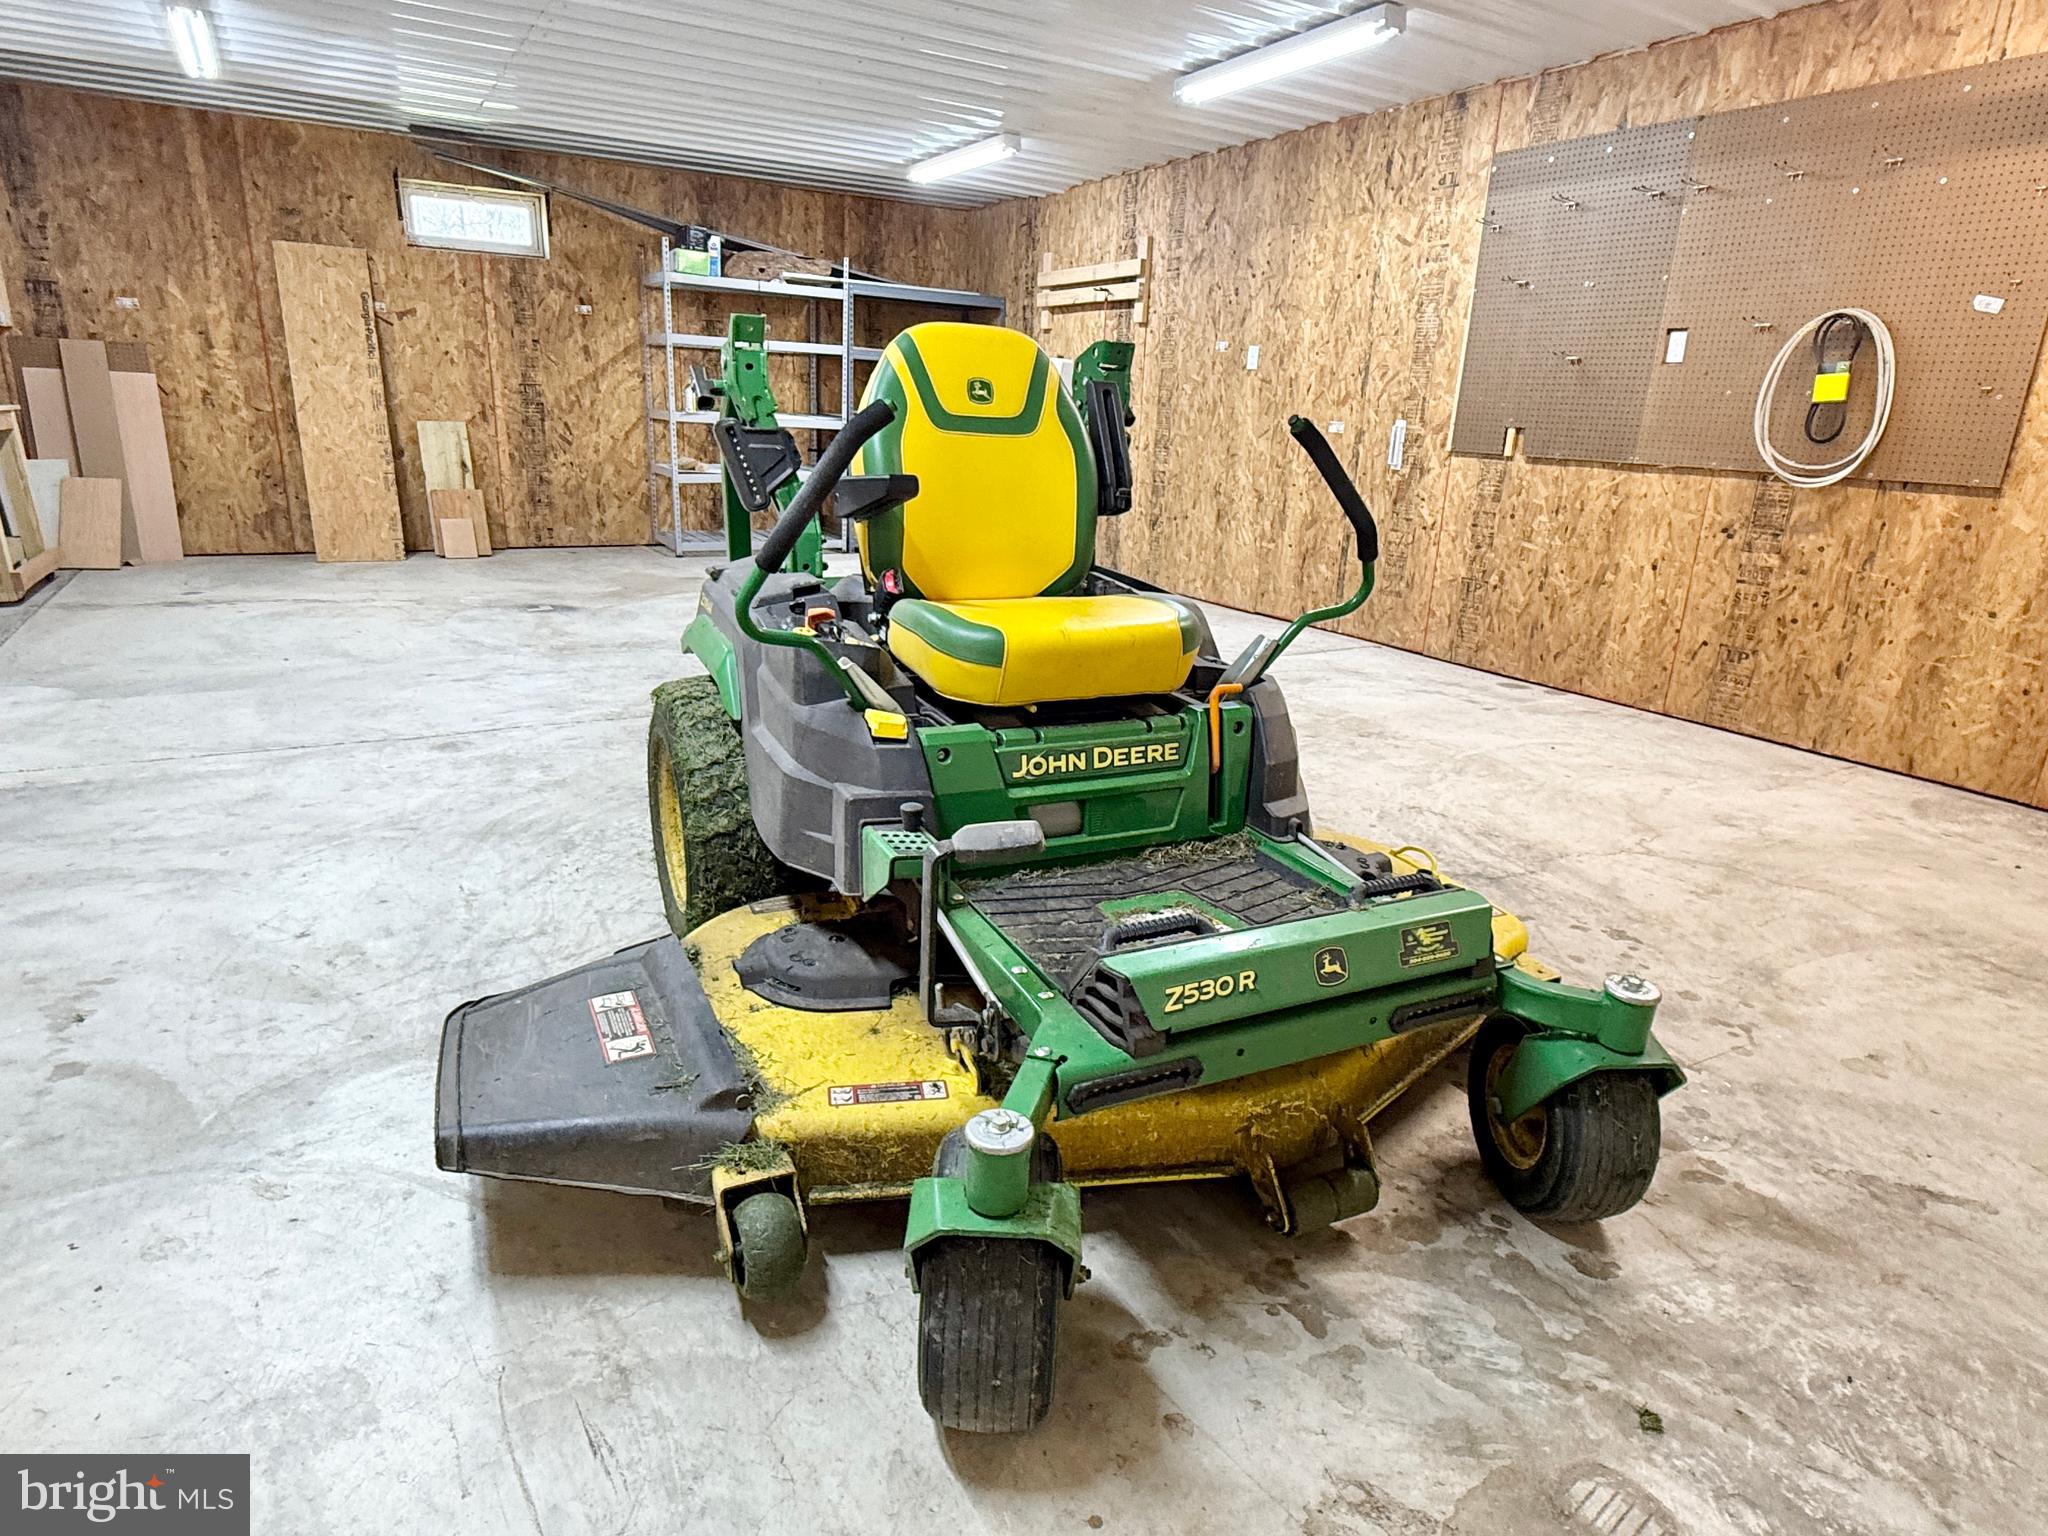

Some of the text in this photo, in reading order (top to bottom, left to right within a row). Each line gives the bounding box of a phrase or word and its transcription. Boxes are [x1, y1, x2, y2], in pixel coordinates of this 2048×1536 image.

[1725, 648, 1750, 664] LP
[1011, 743, 1180, 779] JOHN DEERE
